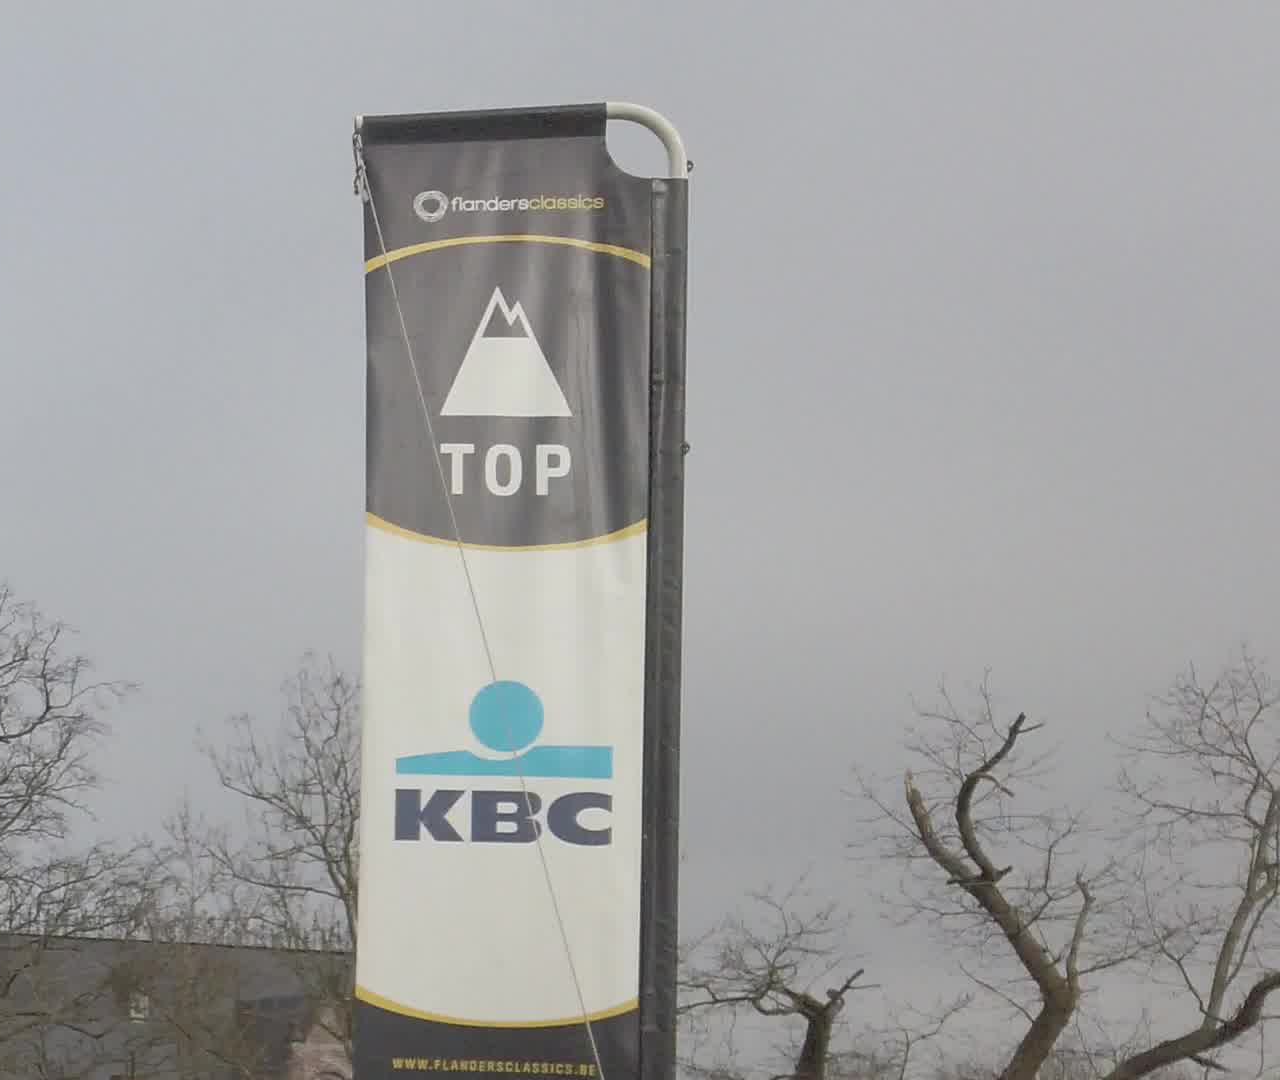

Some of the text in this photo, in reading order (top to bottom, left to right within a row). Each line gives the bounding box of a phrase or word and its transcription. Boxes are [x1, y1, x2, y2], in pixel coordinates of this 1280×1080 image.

[450, 195, 605, 213] flandersclassics
[440, 443, 571, 496] TOP
[394, 788, 613, 847] KBC
[391, 1057, 597, 1077] WWW.FLANDERSCLASSICS.BE
